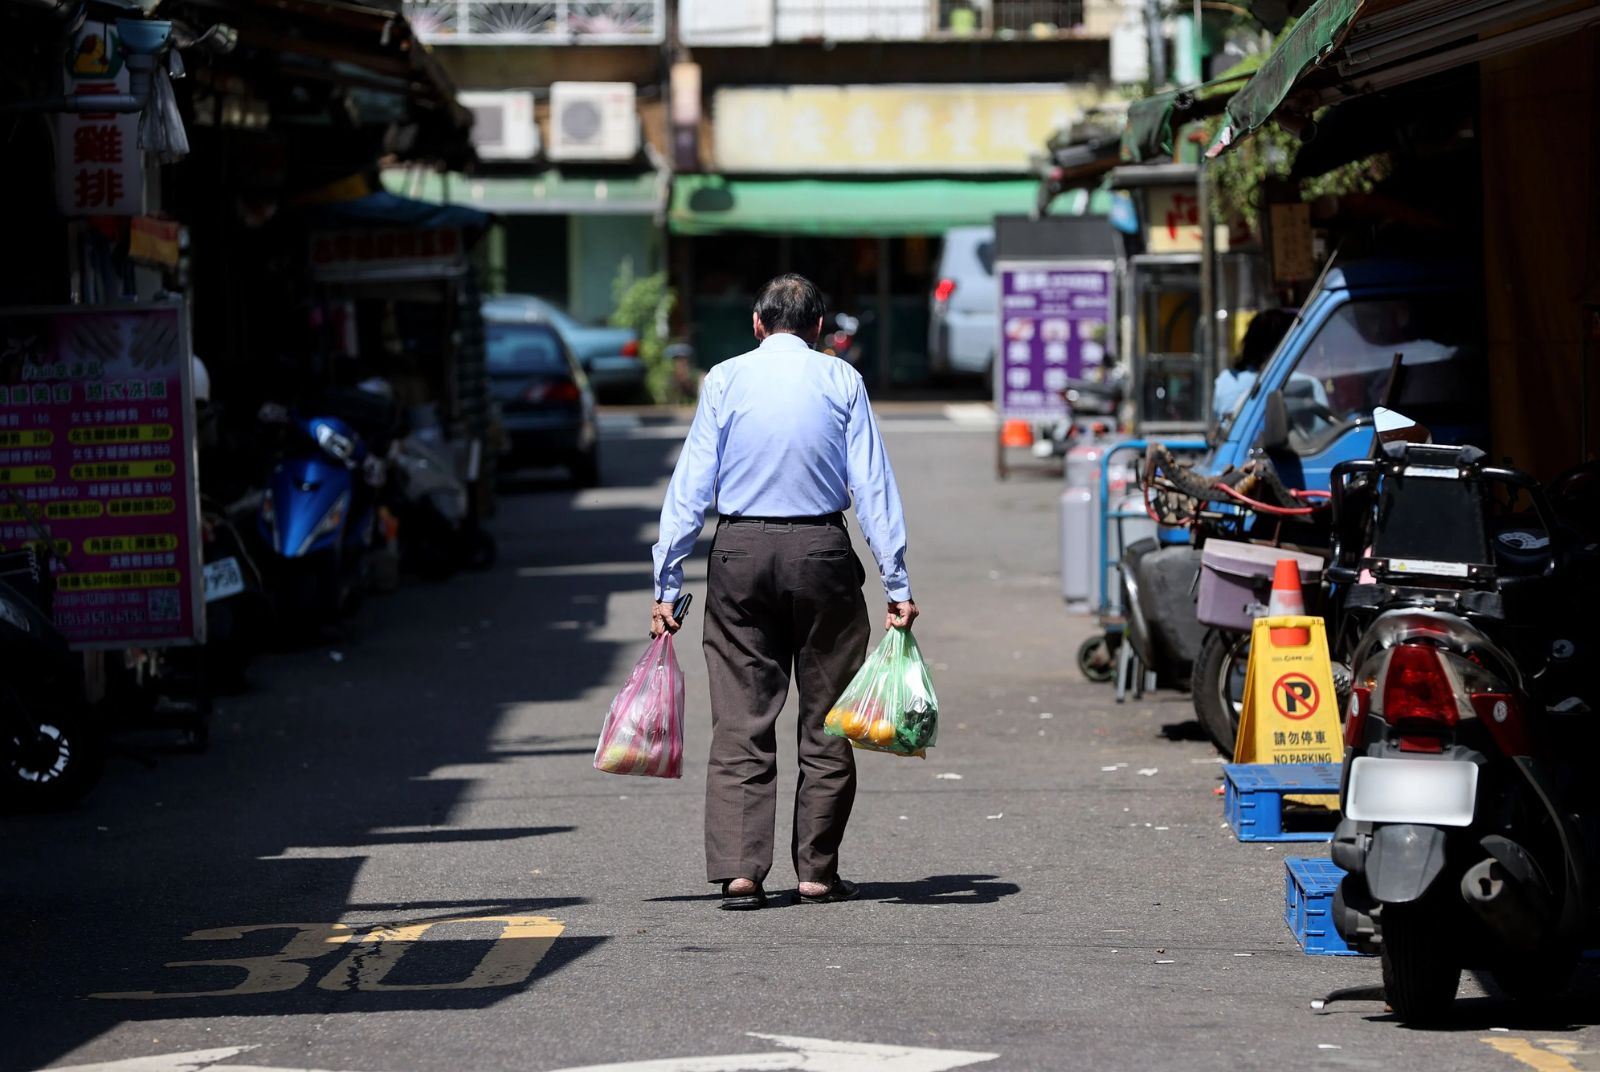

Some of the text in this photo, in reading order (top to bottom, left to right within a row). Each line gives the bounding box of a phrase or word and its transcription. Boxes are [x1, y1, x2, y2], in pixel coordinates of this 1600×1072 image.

[1273, 730, 1327, 746] 請勿停車
[1274, 752, 1332, 764] NO PARKING
[88, 916, 566, 999] 30
